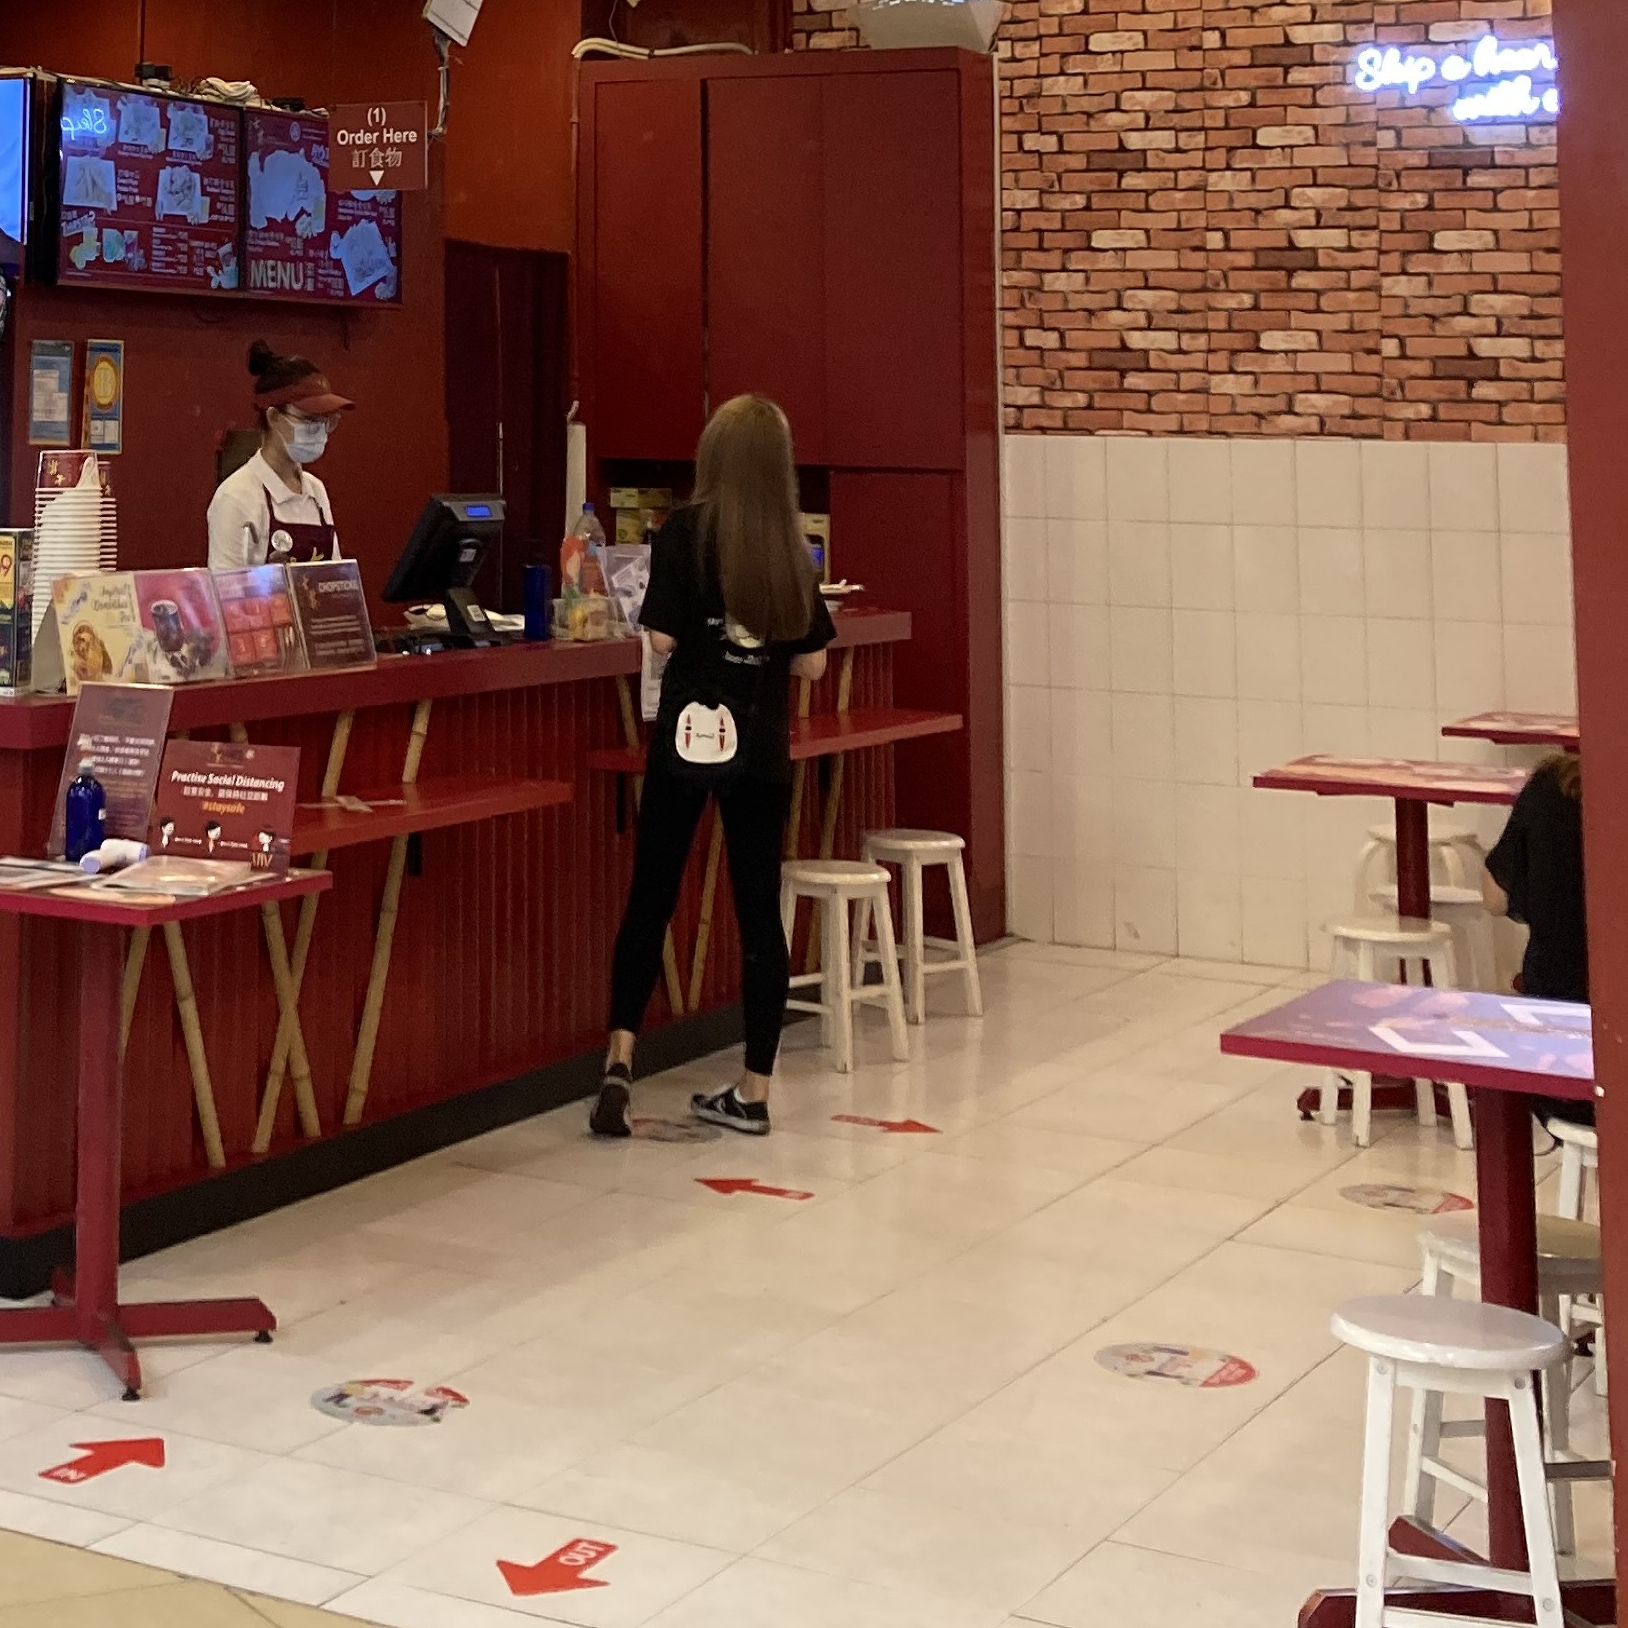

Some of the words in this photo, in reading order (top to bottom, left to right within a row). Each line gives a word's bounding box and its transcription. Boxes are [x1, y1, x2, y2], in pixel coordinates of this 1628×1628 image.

[367, 107, 386, 126] (1)
[337, 129, 379, 145] Order
[382, 128, 418, 144] Here
[351, 147, 402, 168] 訂食物
[250, 259, 305, 291] MENU
[171, 770, 207, 784] Practise
[207, 773, 236, 785] Social
[236, 775, 285, 792] Distancing
[559, 1541, 605, 1566] OUT
